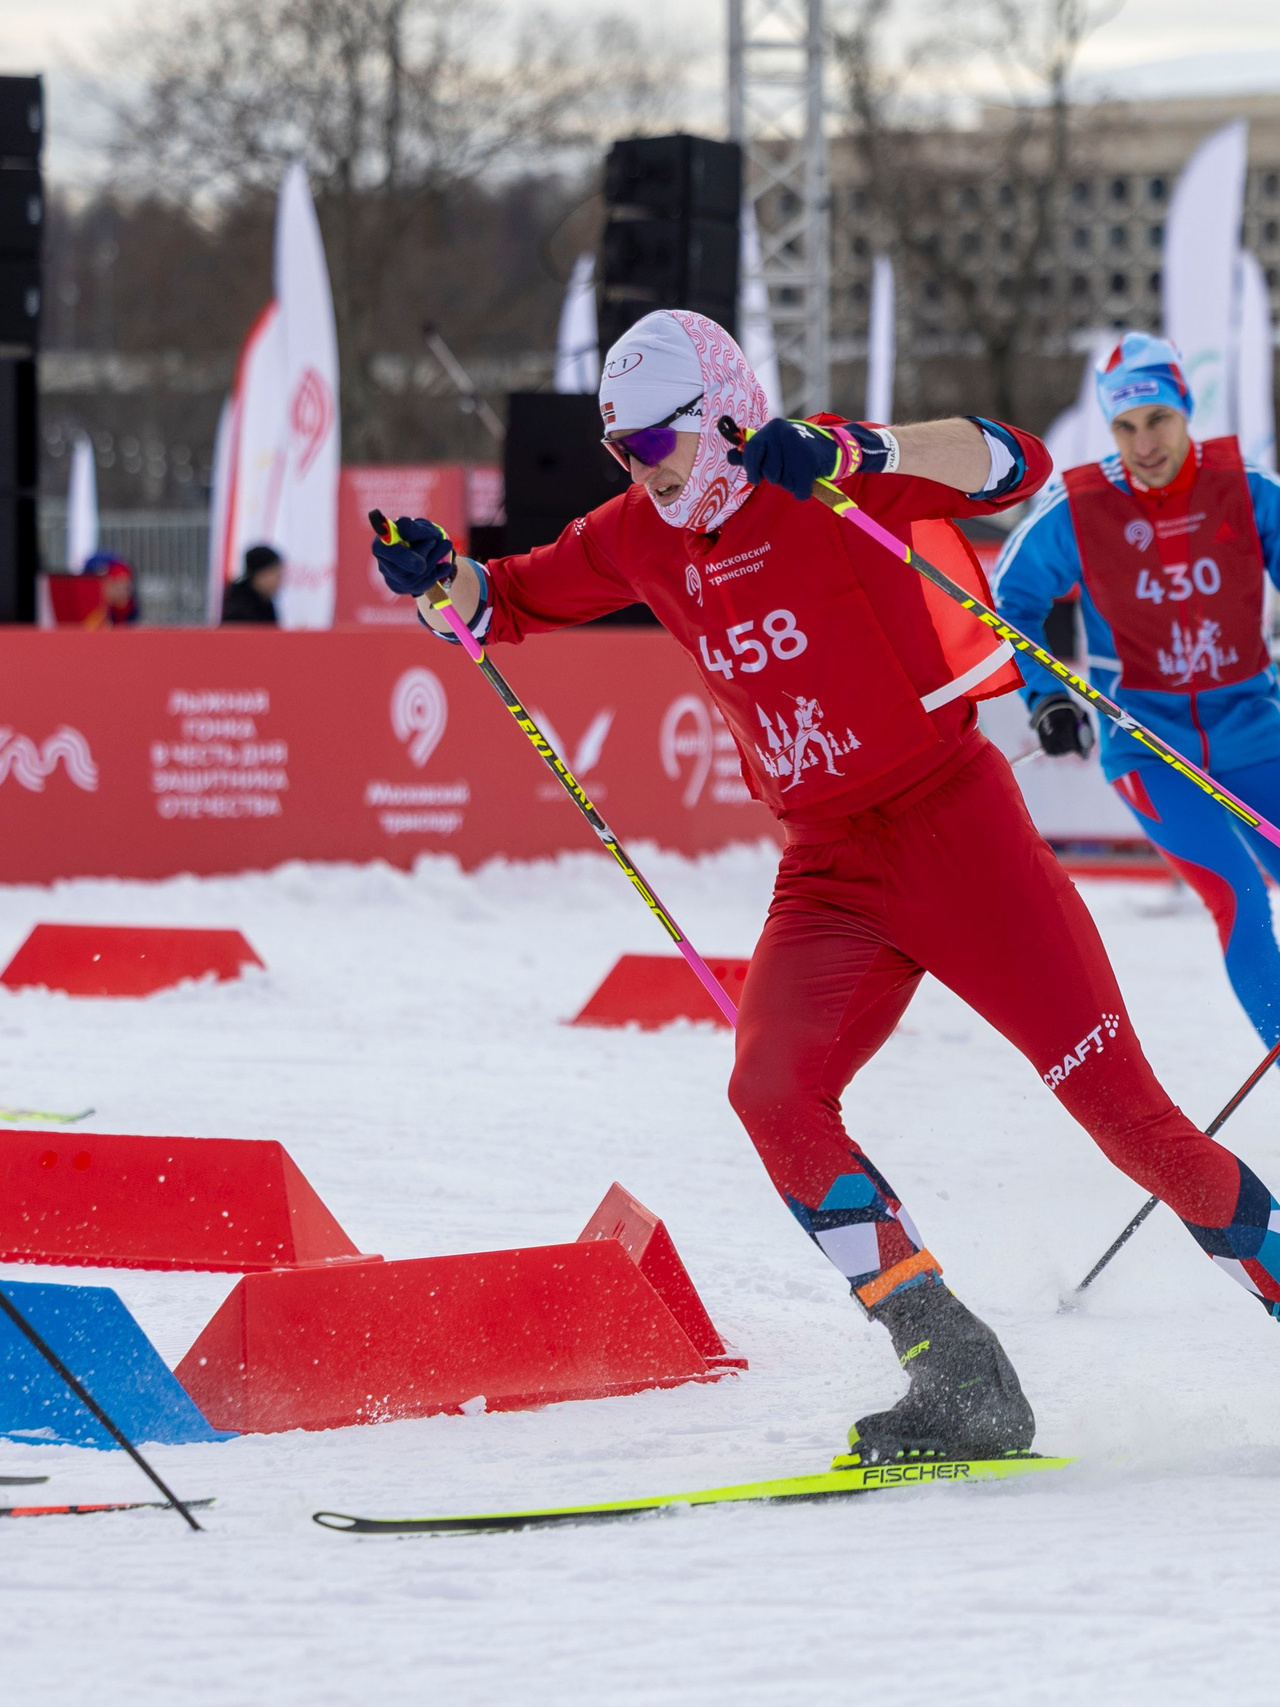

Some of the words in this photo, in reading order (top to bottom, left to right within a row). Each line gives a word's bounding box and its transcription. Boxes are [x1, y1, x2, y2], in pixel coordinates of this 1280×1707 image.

[704, 541, 772, 575] Московский
[708, 559, 765, 587] транспорт
[1135, 557, 1221, 605] 430
[699, 609, 808, 681] 458
[1043, 1024, 1104, 1091] CRAFT
[863, 1464, 970, 1485] FISCHER
